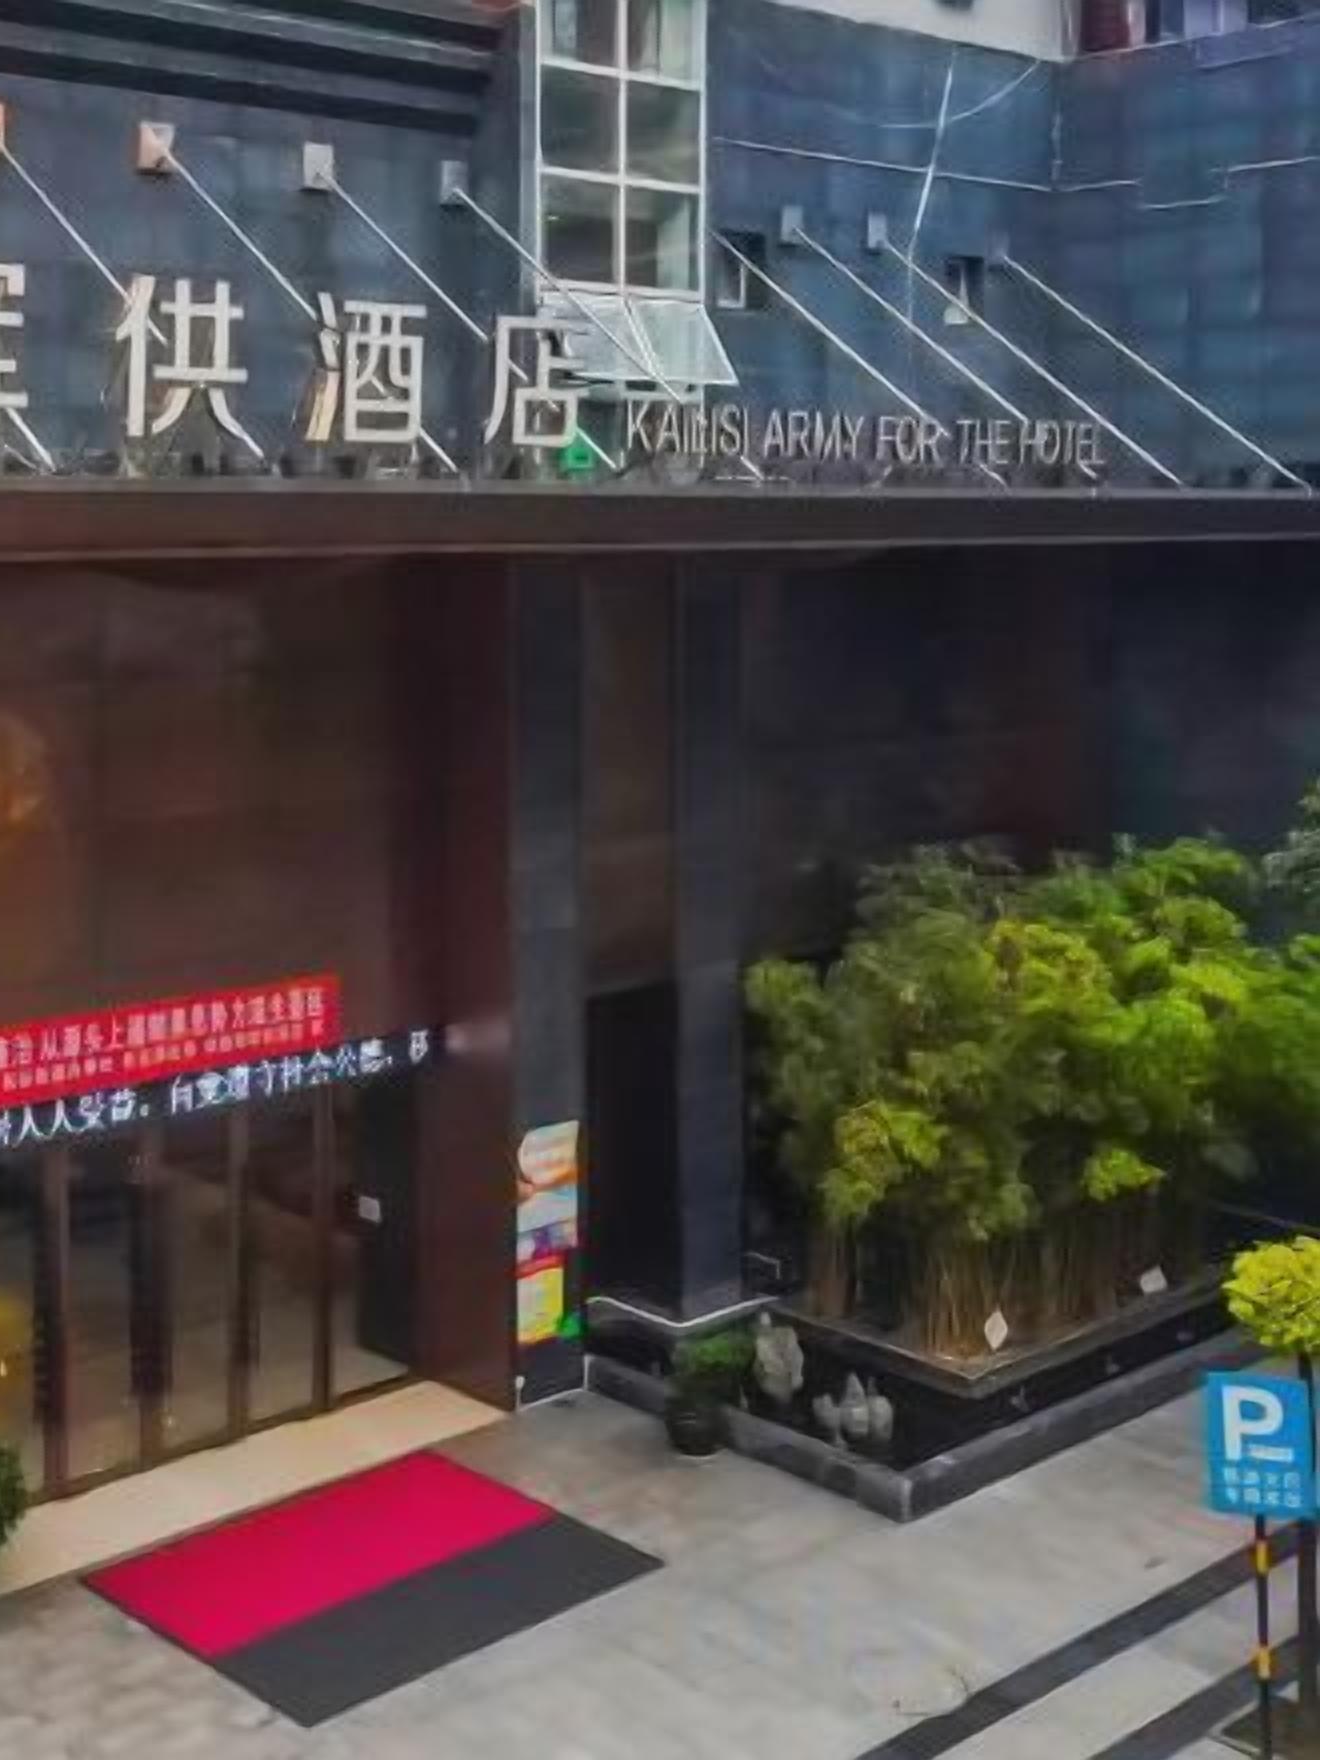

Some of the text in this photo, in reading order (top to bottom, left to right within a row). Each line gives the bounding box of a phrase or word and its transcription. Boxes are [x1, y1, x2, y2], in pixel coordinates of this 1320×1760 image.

[763, 407, 861, 461] ARMY
[876, 415, 943, 465] FOR
[957, 418, 1011, 466] THE
[1017, 417, 1105, 467] HOTEL
[1221, 1384, 1284, 1461] P
